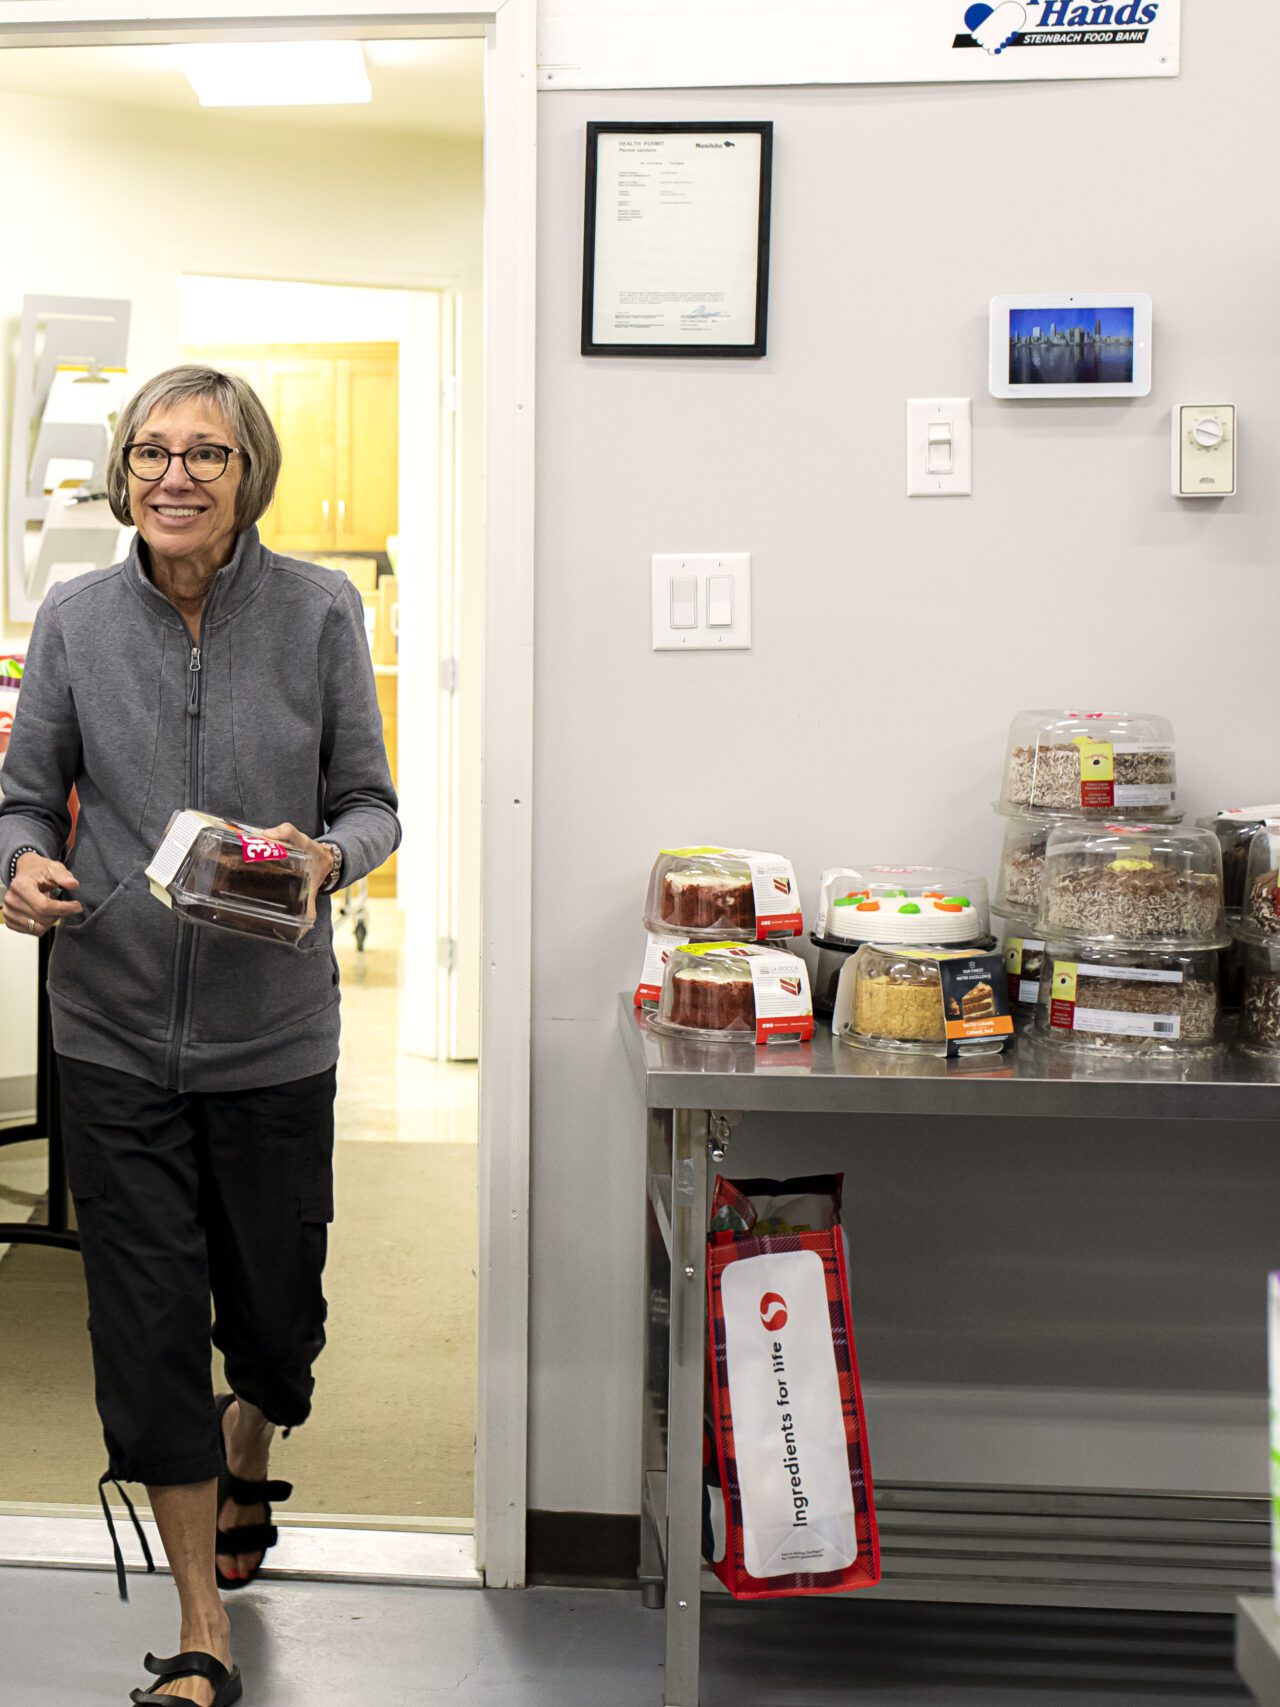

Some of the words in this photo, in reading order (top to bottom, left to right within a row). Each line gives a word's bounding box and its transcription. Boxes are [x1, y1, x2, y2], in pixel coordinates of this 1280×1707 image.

[1035, 0, 1159, 27] Hands
[1023, 33, 1082, 44] STEINBACH
[1083, 32, 1114, 42] FOOD
[1115, 31, 1145, 42] BANK
[771, 1341, 785, 1373] life
[776, 1379, 790, 1407] for
[781, 1412, 809, 1527] Ingredients
